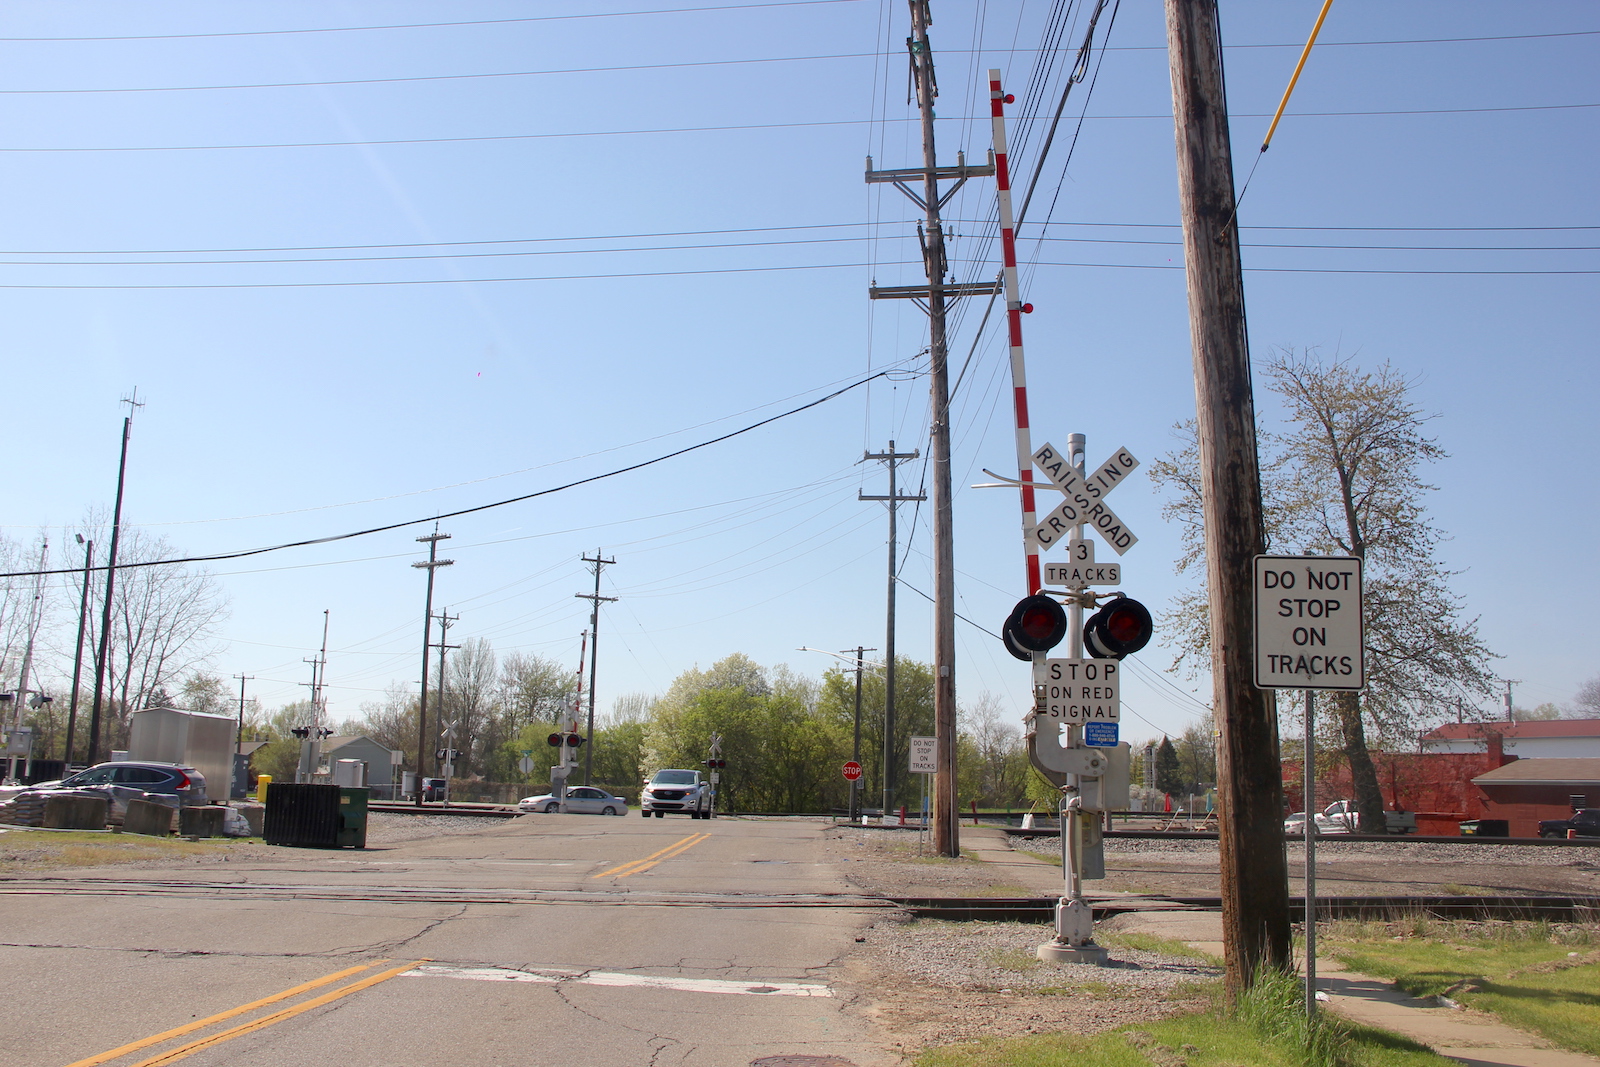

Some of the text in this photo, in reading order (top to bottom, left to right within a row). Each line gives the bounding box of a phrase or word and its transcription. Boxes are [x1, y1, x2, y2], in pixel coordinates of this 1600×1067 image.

[1037, 453, 1133, 544] CROSSING
[1076, 544, 1088, 560] 3
[1048, 568, 1117, 581] TRACKS
[1264, 570, 1353, 590] DO NOT
[1278, 598, 1341, 618] STOP
[1292, 627, 1326, 646] ON
[1050, 663, 1116, 681] STOP
[1267, 654, 1352, 675] TRACKS
[1051, 686, 1114, 699] ON RED
[1051, 705, 1117, 718] SIGNAL
[912, 762, 935, 770] TRACKS
